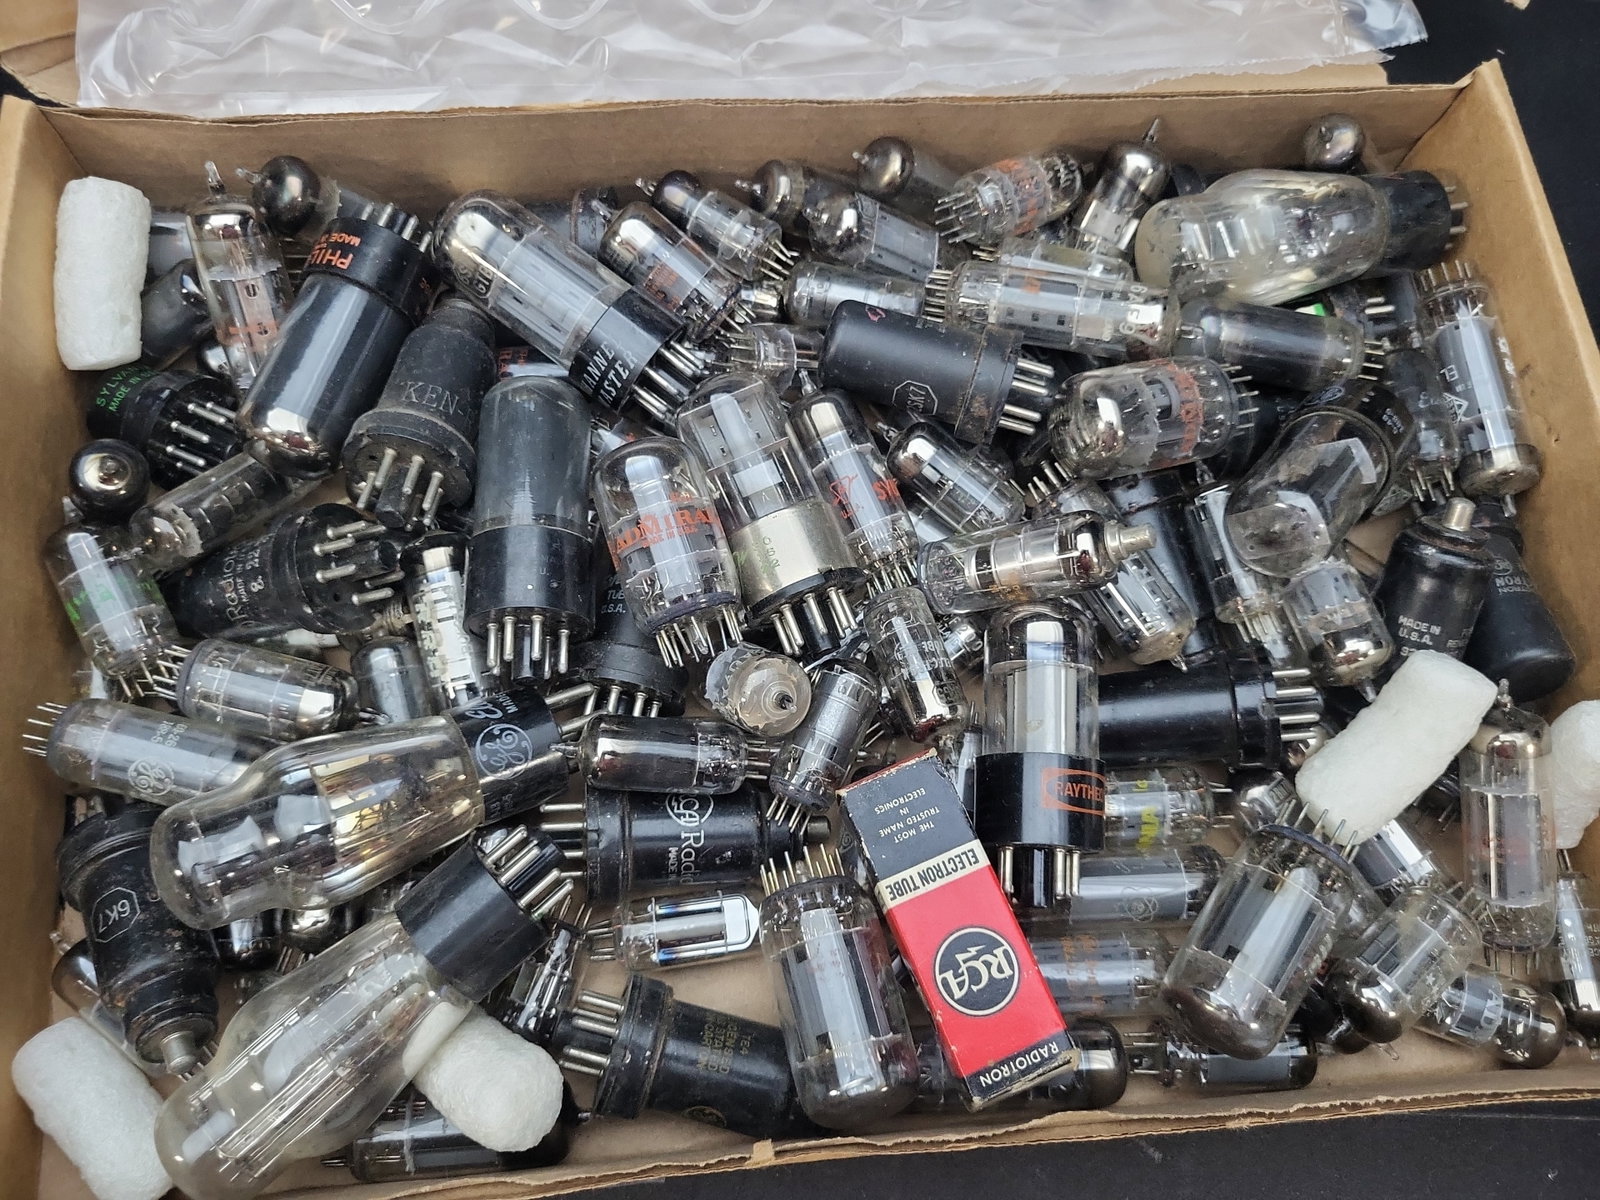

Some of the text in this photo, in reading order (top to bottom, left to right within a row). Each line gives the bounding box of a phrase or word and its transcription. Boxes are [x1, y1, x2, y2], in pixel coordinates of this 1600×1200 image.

[1398, 614, 1430, 633] MADE
[1398, 627, 1433, 646] U.S.A.
[874, 787, 926, 815] ELECTRONICS
[900, 806, 910, 816] IN
[879, 806, 940, 837] TRUSTED NAME
[893, 820, 935, 844] THE MOST
[885, 848, 980, 901] ELECTRON TUBE
[99, 899, 131, 934] 6K7
[939, 945, 1014, 1000] RCA
[979, 1041, 1060, 1088] RADIOTRON
